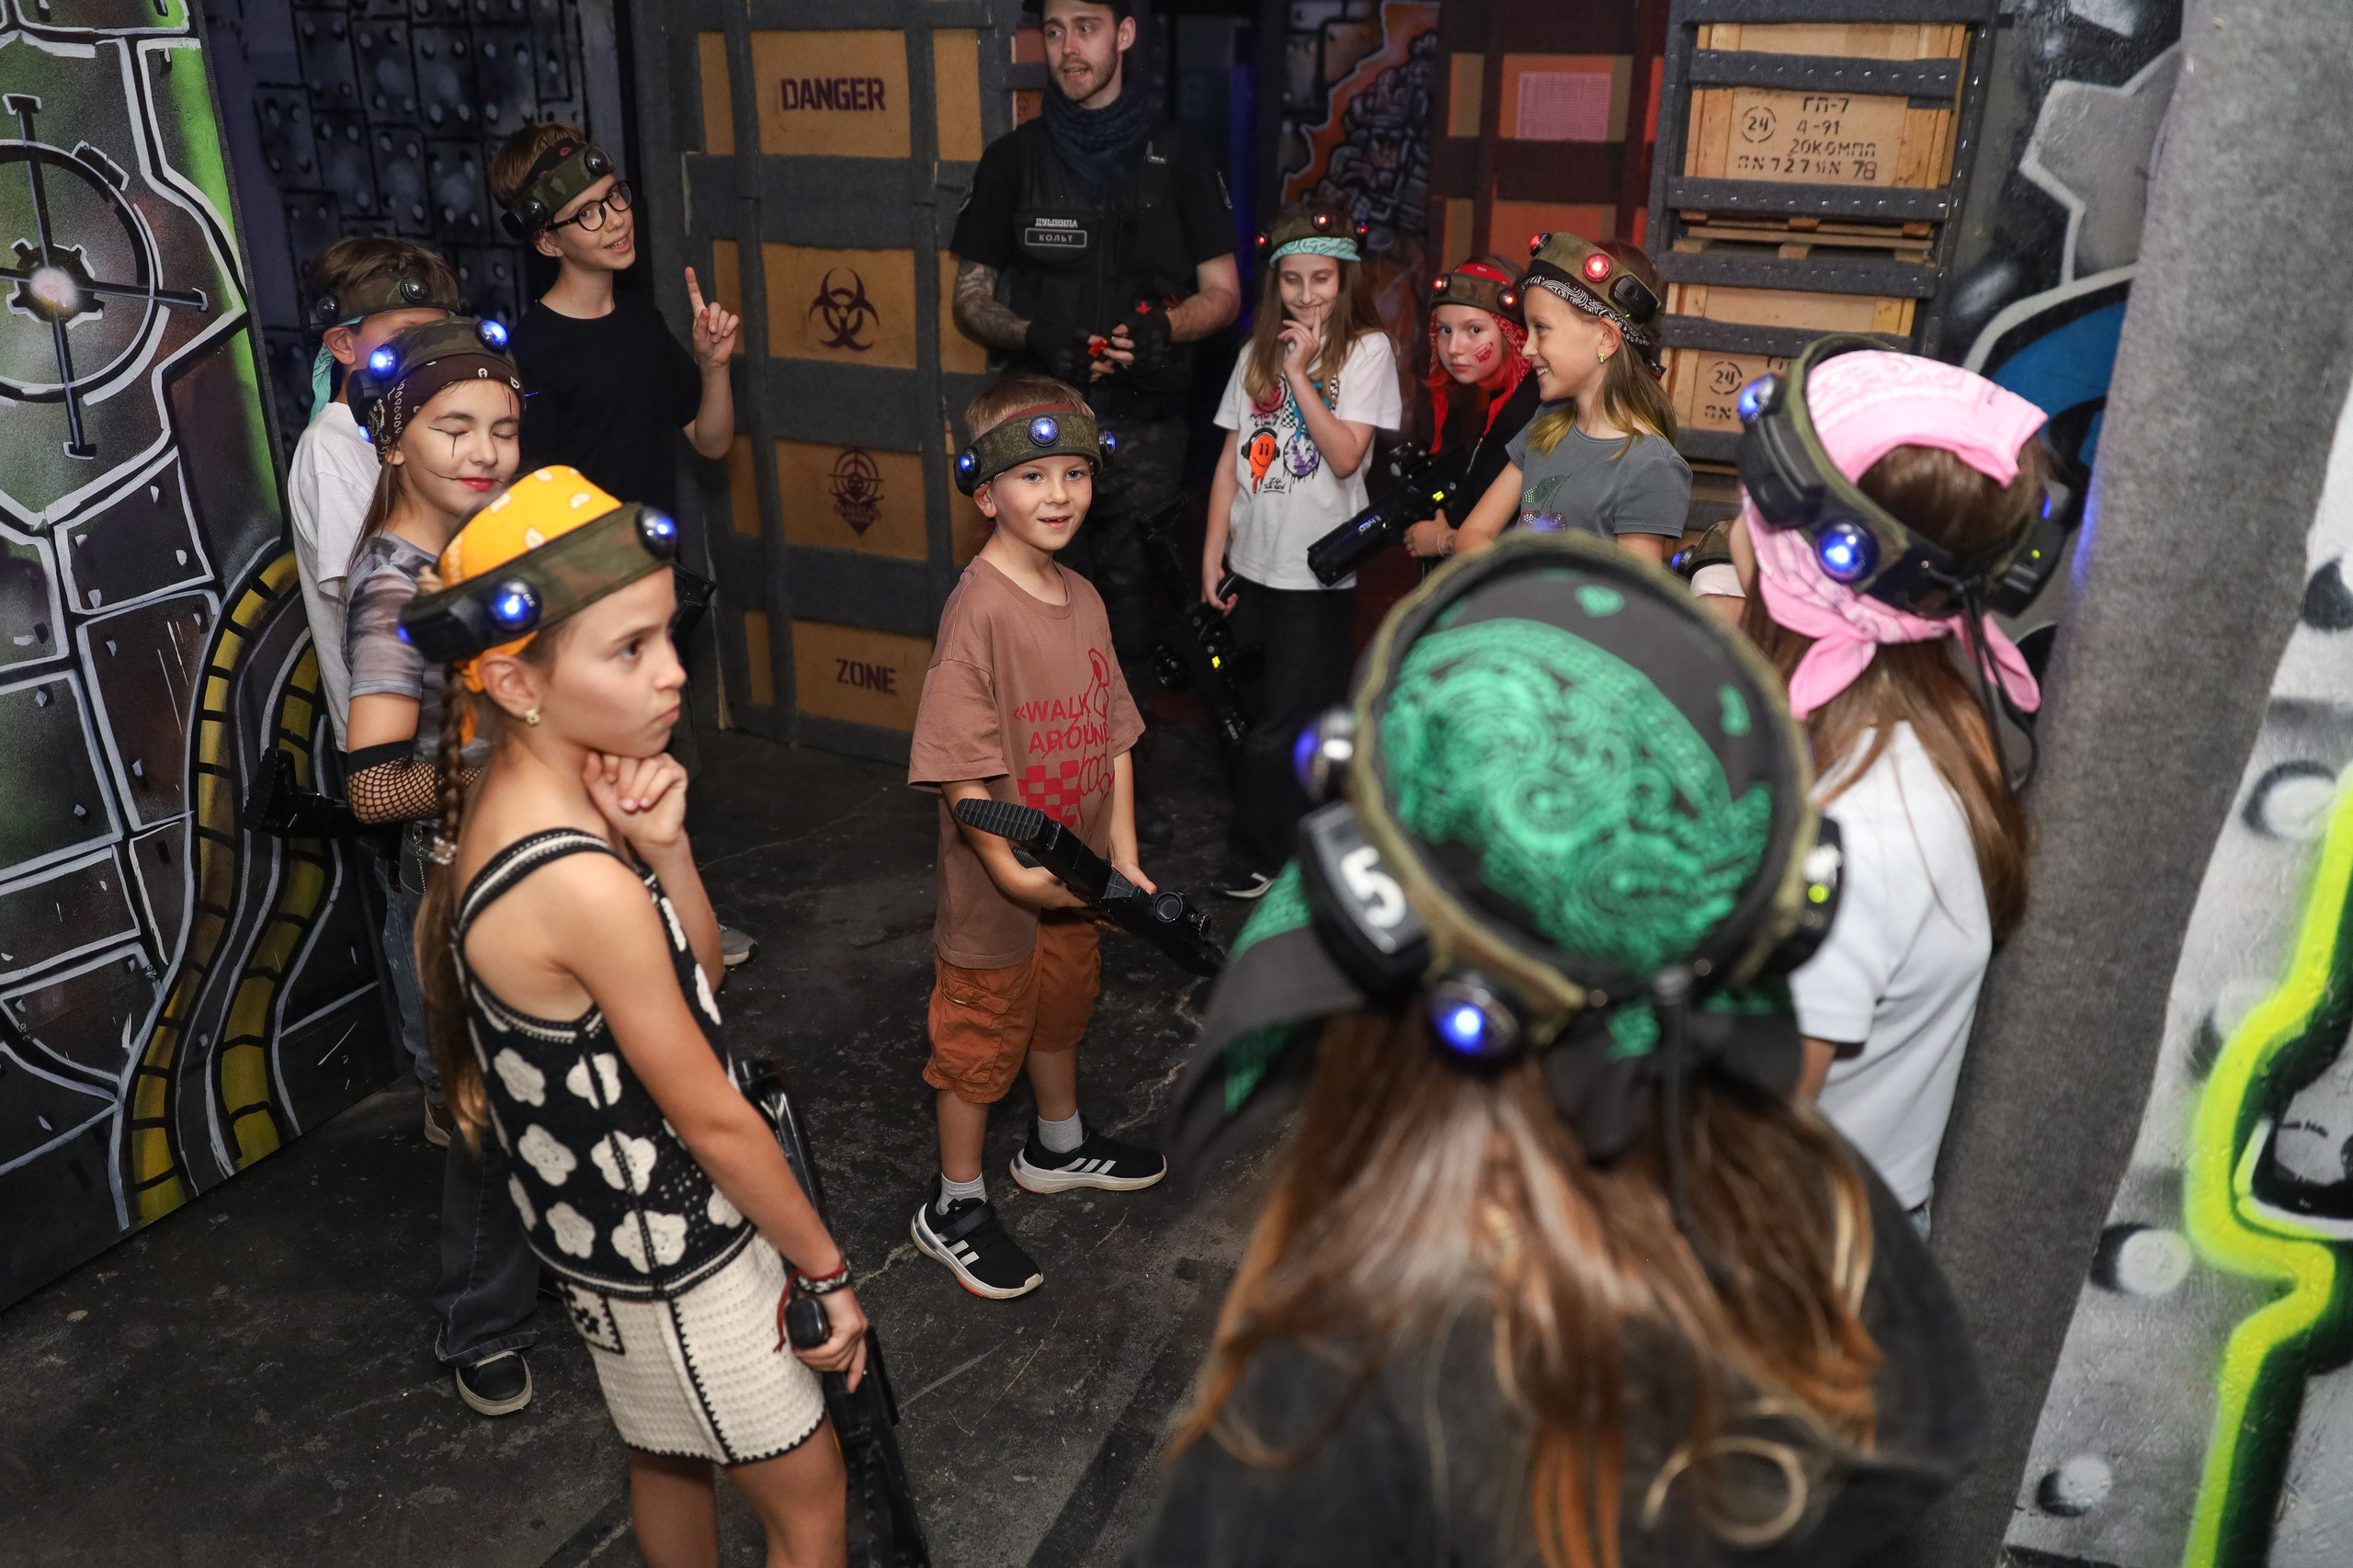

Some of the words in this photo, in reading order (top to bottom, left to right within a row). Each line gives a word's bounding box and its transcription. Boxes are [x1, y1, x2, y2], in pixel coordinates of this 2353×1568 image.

[780, 77, 887, 110] DANGER
[1747, 115, 1769, 131] 24
[1853, 159, 1878, 180] 78
[1039, 233, 1074, 243] КОЛЬТ
[1715, 369, 1735, 384] 24
[835, 657, 897, 695] ZONE
[1029, 722, 1110, 756] AROUND
[1341, 845, 1408, 929] 5
